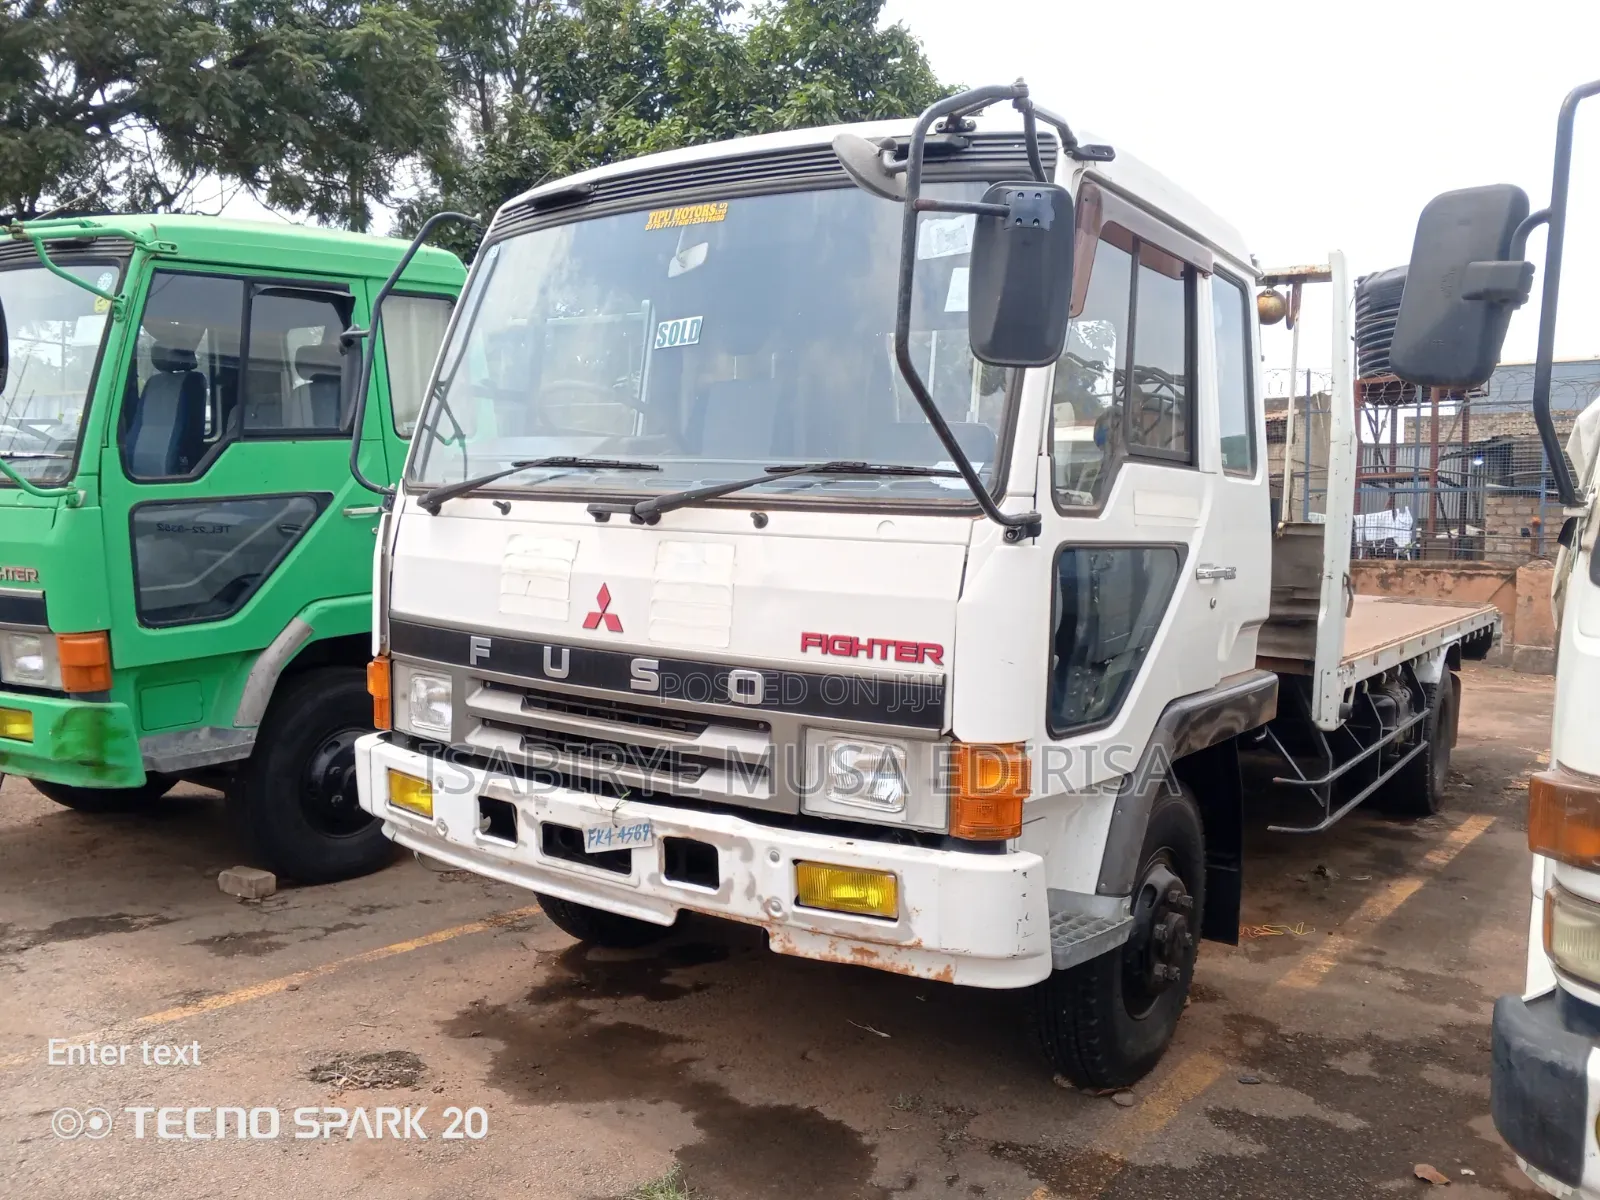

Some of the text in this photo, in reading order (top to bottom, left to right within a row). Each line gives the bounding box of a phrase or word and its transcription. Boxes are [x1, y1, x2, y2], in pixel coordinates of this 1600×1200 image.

[647, 209, 673, 224] TIPU
[673, 203, 717, 220] MOTORS
[656, 318, 701, 347] SOLD
[800, 631, 944, 666] FIGHTER
[469, 635, 765, 706] FUSO
